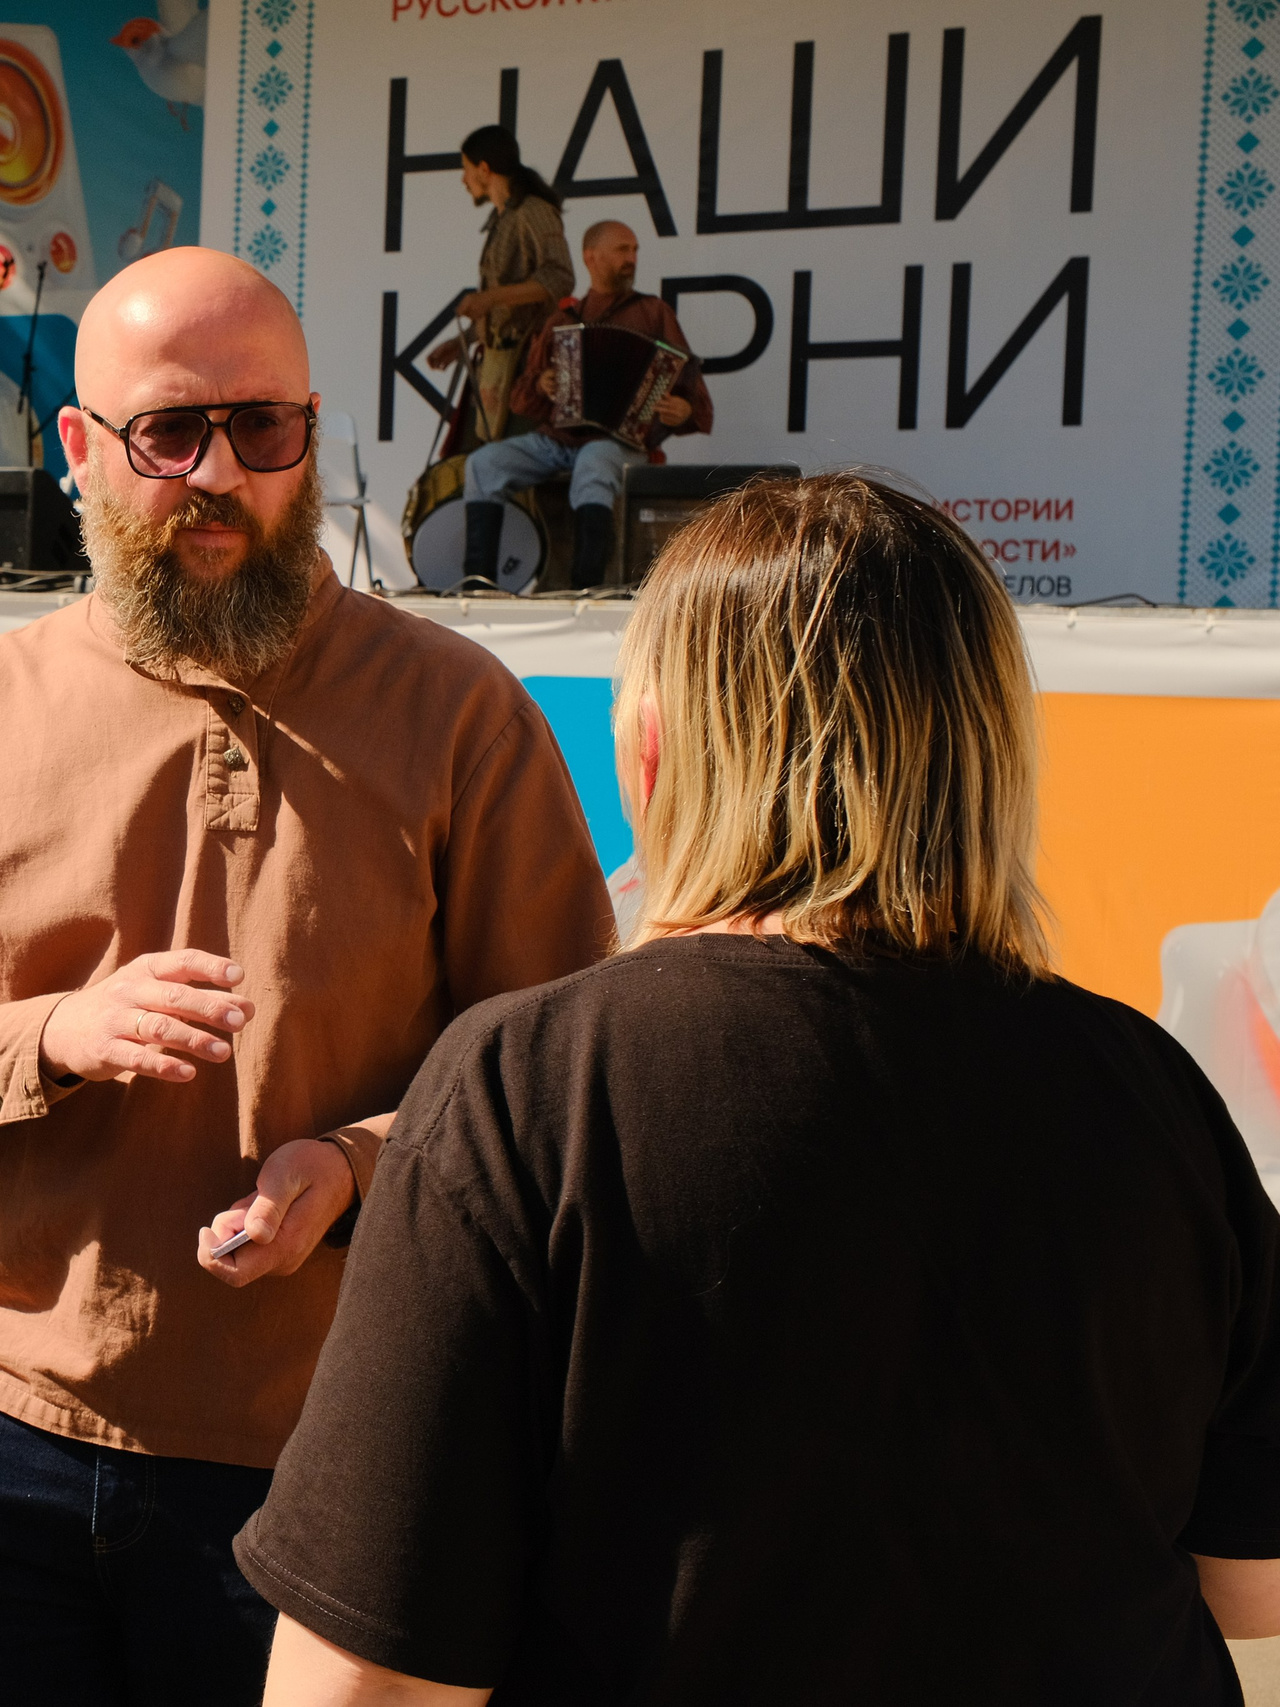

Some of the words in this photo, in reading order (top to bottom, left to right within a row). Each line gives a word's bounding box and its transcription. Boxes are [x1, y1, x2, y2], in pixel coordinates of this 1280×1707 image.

[384, 15, 1103, 253] НАШИ
[378, 256, 1090, 442] КРНИ
[979, 539, 1077, 563] ОСТИ»
[1003, 575, 1072, 598] ЕЛОВ
